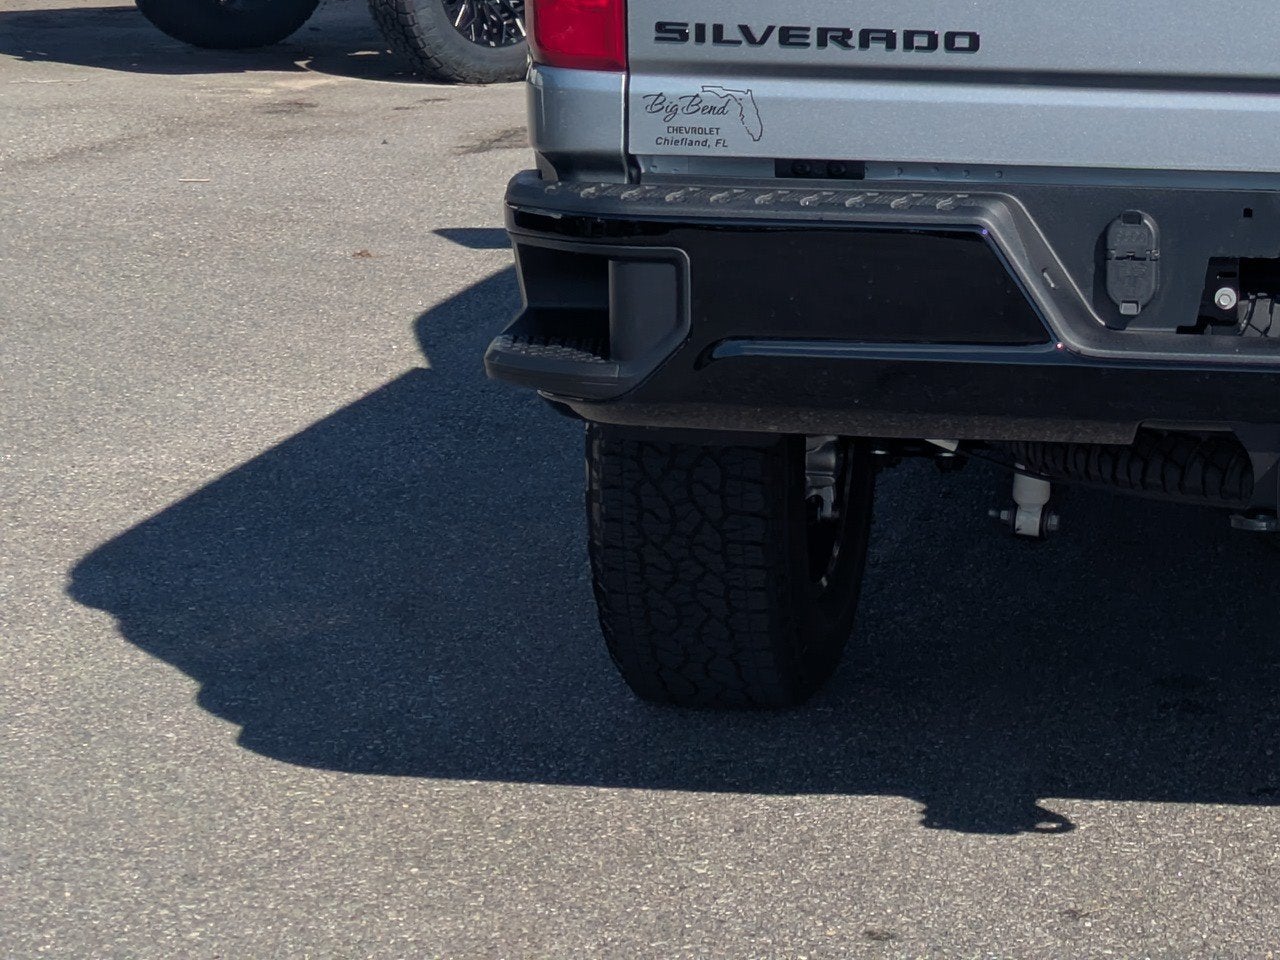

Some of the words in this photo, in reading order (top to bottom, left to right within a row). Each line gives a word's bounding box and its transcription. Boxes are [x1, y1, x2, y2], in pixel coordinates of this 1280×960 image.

[653, 21, 981, 54] SILVERADO
[642, 92, 679, 122] Big
[678, 93, 732, 116] Bend
[666, 125, 721, 136] CHEVROLET
[655, 136, 711, 149] Chiefland,
[715, 138, 729, 148] FL
